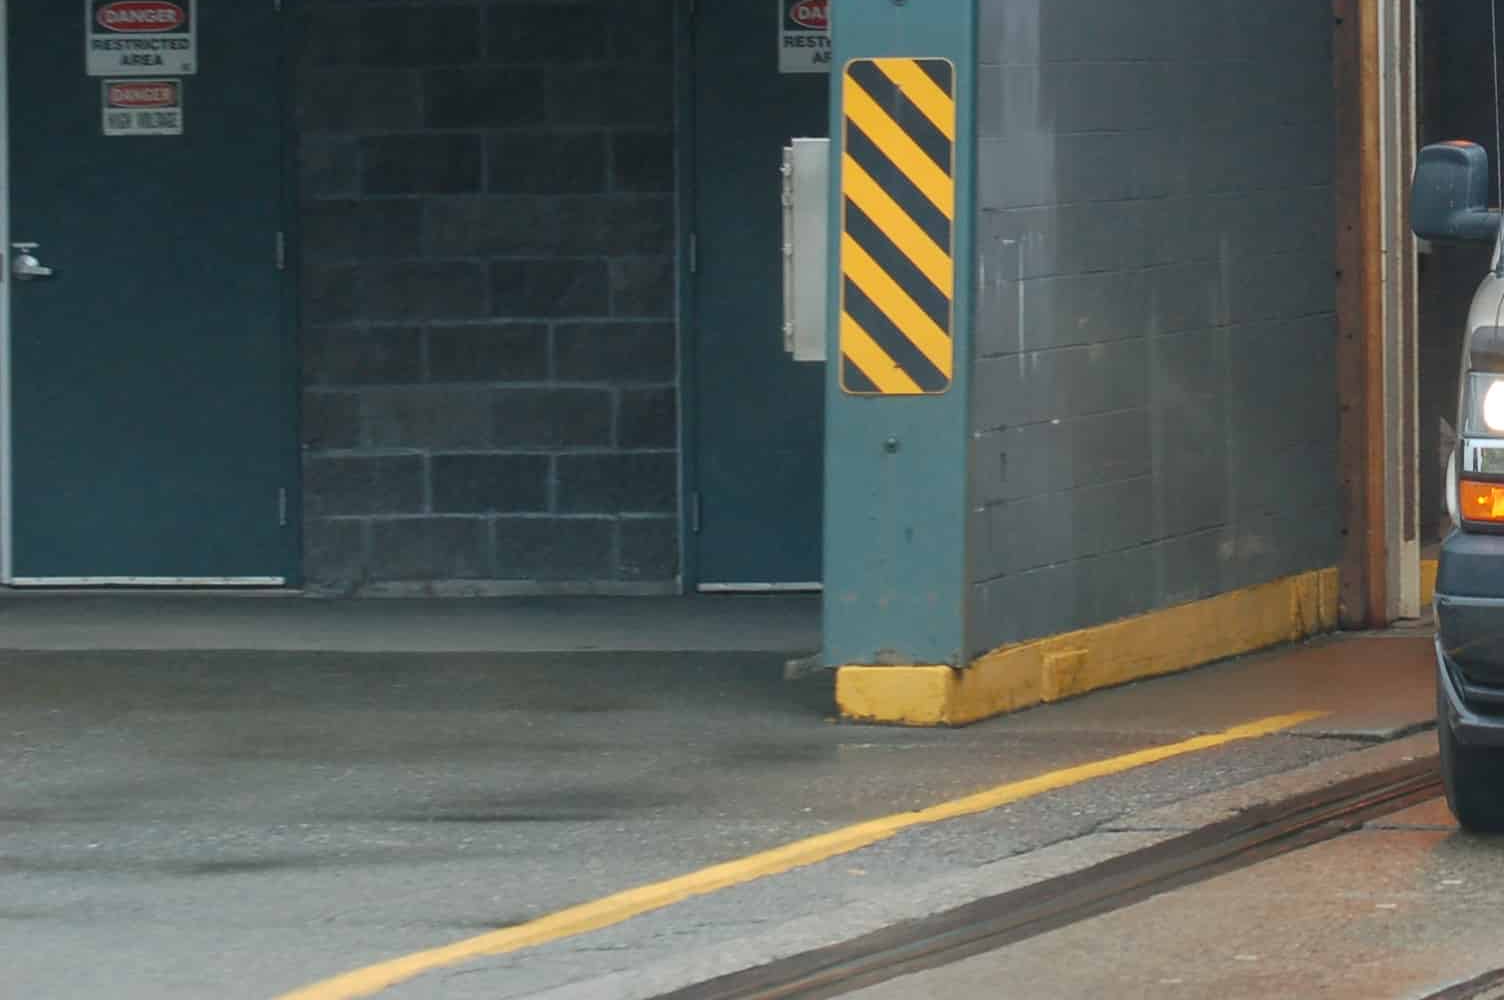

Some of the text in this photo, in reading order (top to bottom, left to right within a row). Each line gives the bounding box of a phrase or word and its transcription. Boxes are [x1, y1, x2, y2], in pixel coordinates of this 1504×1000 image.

[103, 8, 177, 24] DANGER
[92, 38, 191, 51] RESTRICTED
[121, 54, 163, 66] AREA
